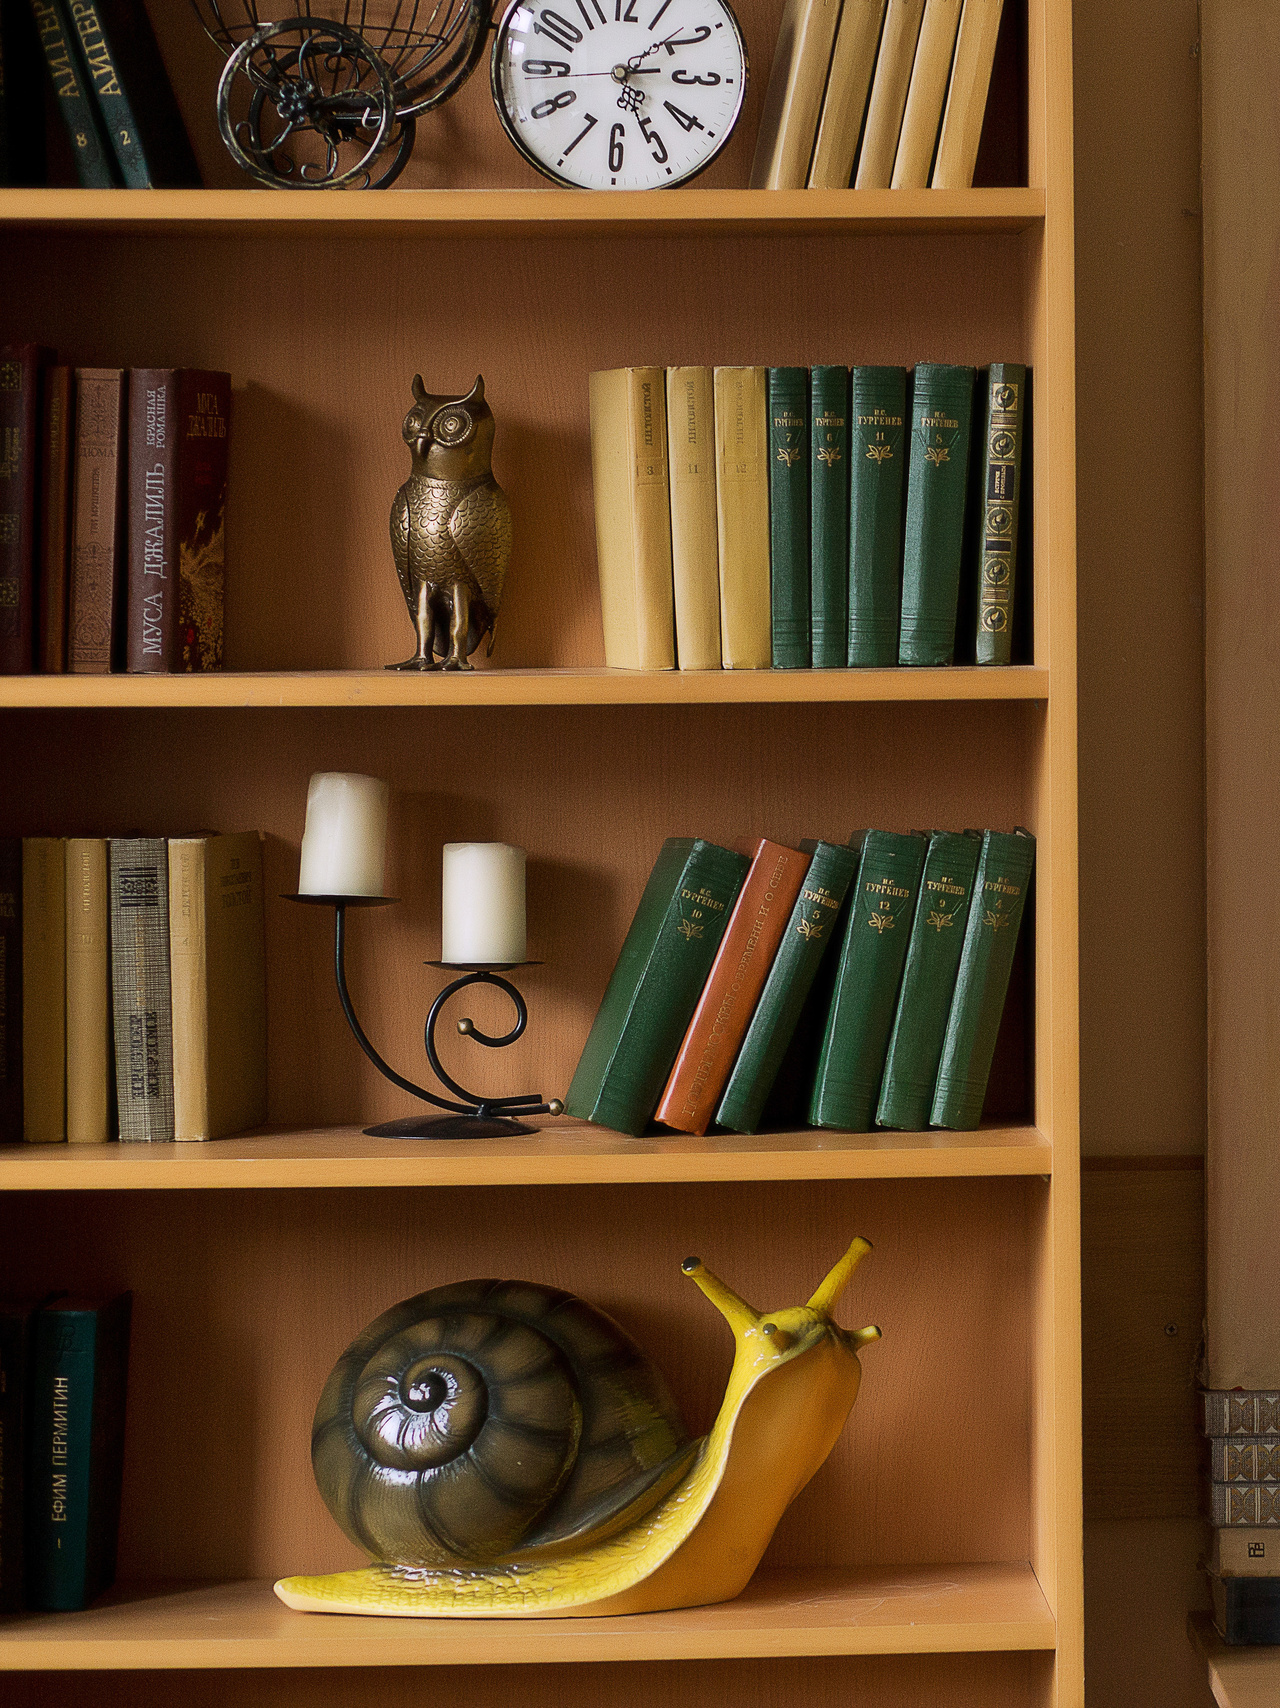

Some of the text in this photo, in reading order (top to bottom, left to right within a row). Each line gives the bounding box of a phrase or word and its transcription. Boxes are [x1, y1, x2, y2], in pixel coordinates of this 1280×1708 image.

[533, 9, 583, 53] 10
[663, 26, 711, 56] 2
[33, 0, 80, 97] А.И.ГЕР
[69, 0, 122, 95] А.И.ГЕР
[522, 59, 571, 77] 9
[671, 69, 721, 86] 3
[531, 90, 577, 120] 8
[663, 100, 704, 133] 4
[120, 130, 131, 145] 2
[563, 113, 599, 157] 7
[608, 123, 625, 172] 6
[638, 116, 669, 164] 5
[147, 389, 156, 446] КРАСНАЯ
[156, 385, 167, 449] РОМАШКА
[857, 416, 902, 426] ТУРГЕНЕВ
[786, 433, 792, 442] 7
[875, 431, 884, 441] 11
[935, 434, 943, 444] 8
[143, 462, 167, 656] МУСА ДЖАЛИЛЬ
[770, 855, 788, 888] СЕБЕ
[681, 889, 724, 911] ТУРГЕНЕВ
[765, 892, 774, 901] О
[865, 882, 909, 898] ТУРГЕНЕВ
[691, 909, 702, 919] 10
[758, 905, 770, 917] И
[812, 910, 821, 919] 5
[879, 901, 891, 911] 12
[735, 920, 764, 981] ВРЕМЕНИ
[732, 983, 740, 991] О
[52, 1377, 68, 1521] ЕФИМ ПЕРМИТИН
